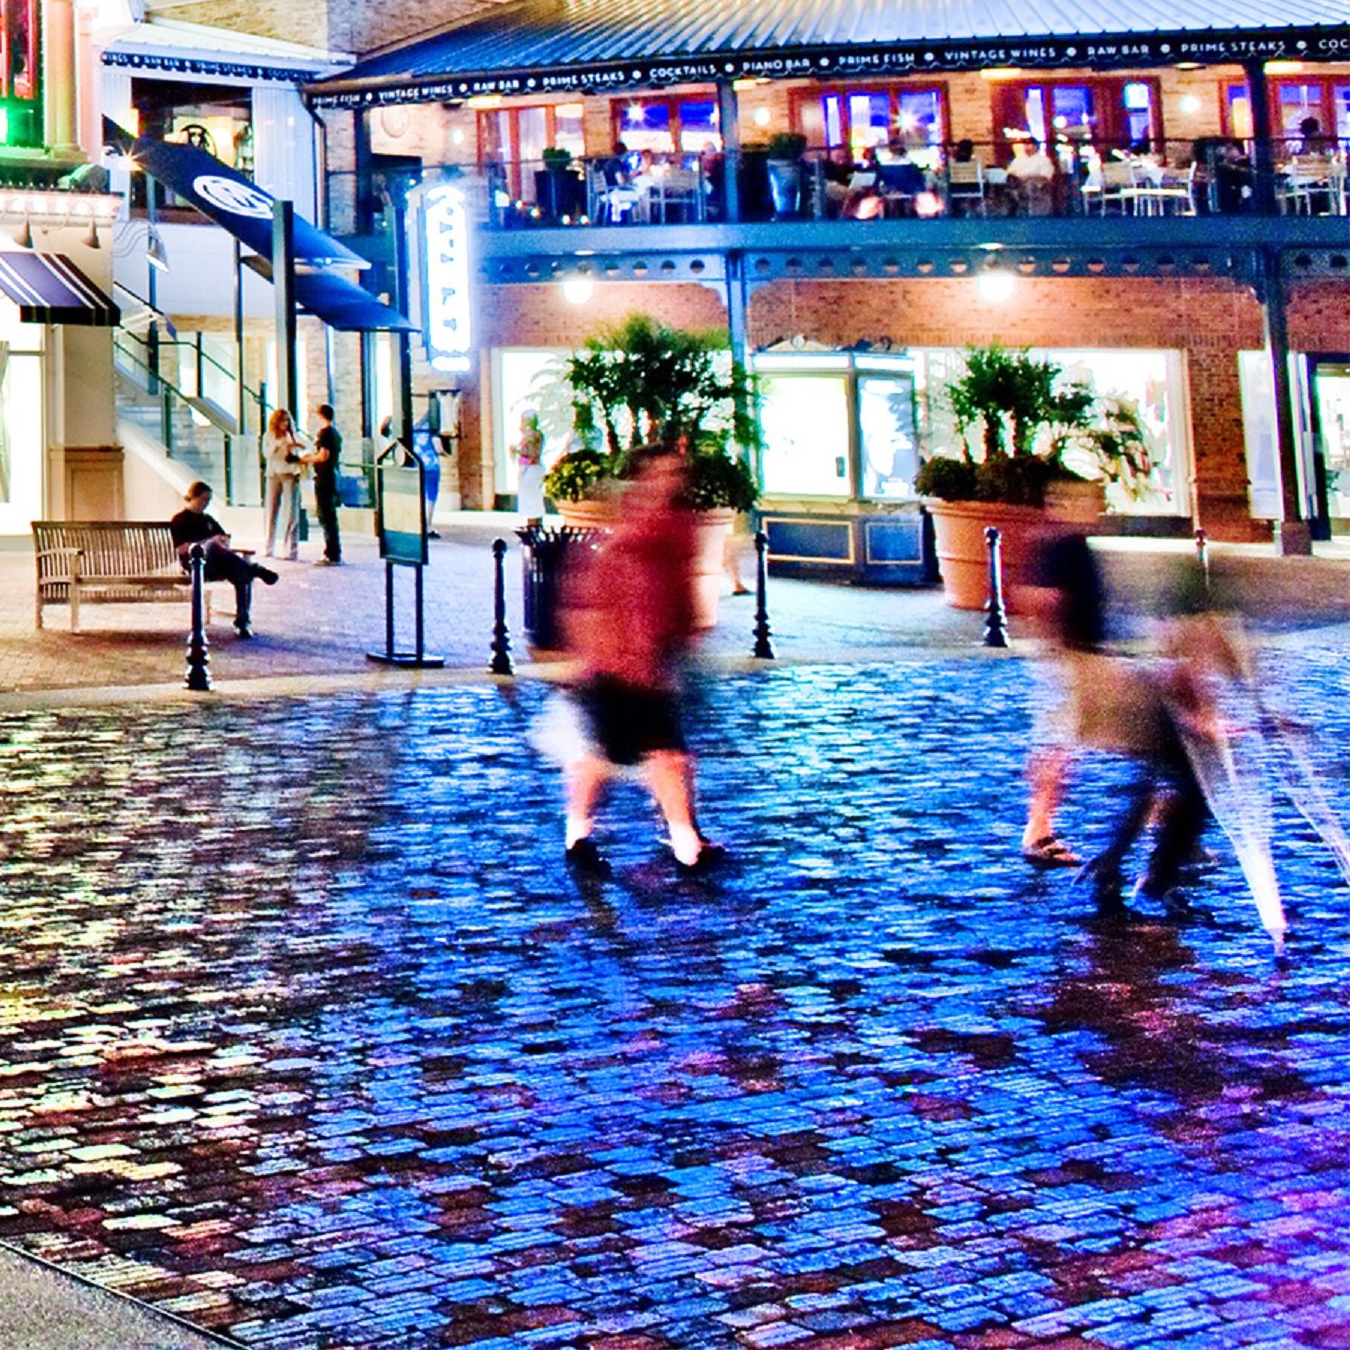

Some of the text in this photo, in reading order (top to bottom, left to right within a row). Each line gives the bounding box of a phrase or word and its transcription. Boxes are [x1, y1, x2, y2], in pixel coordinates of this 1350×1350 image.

[377, 87, 420, 100] VINTAGE
[541, 74, 578, 87] PRIME
[580, 70, 625, 84] STEAKS
[649, 63, 717, 79] COCKTAILS
[741, 60, 783, 72] PIANO
[785, 58, 811, 70] BAR
[838, 55, 880, 66] PRIME
[884, 52, 915, 64] FISH
[944, 49, 1006, 61] VINTAGE
[1010, 47, 1056, 59] WINES
[1086, 45, 1117, 56] RAW
[1121, 43, 1150, 55] BAR
[1180, 42, 1226, 53] PRIME
[1230, 40, 1286, 52] STEAKS
